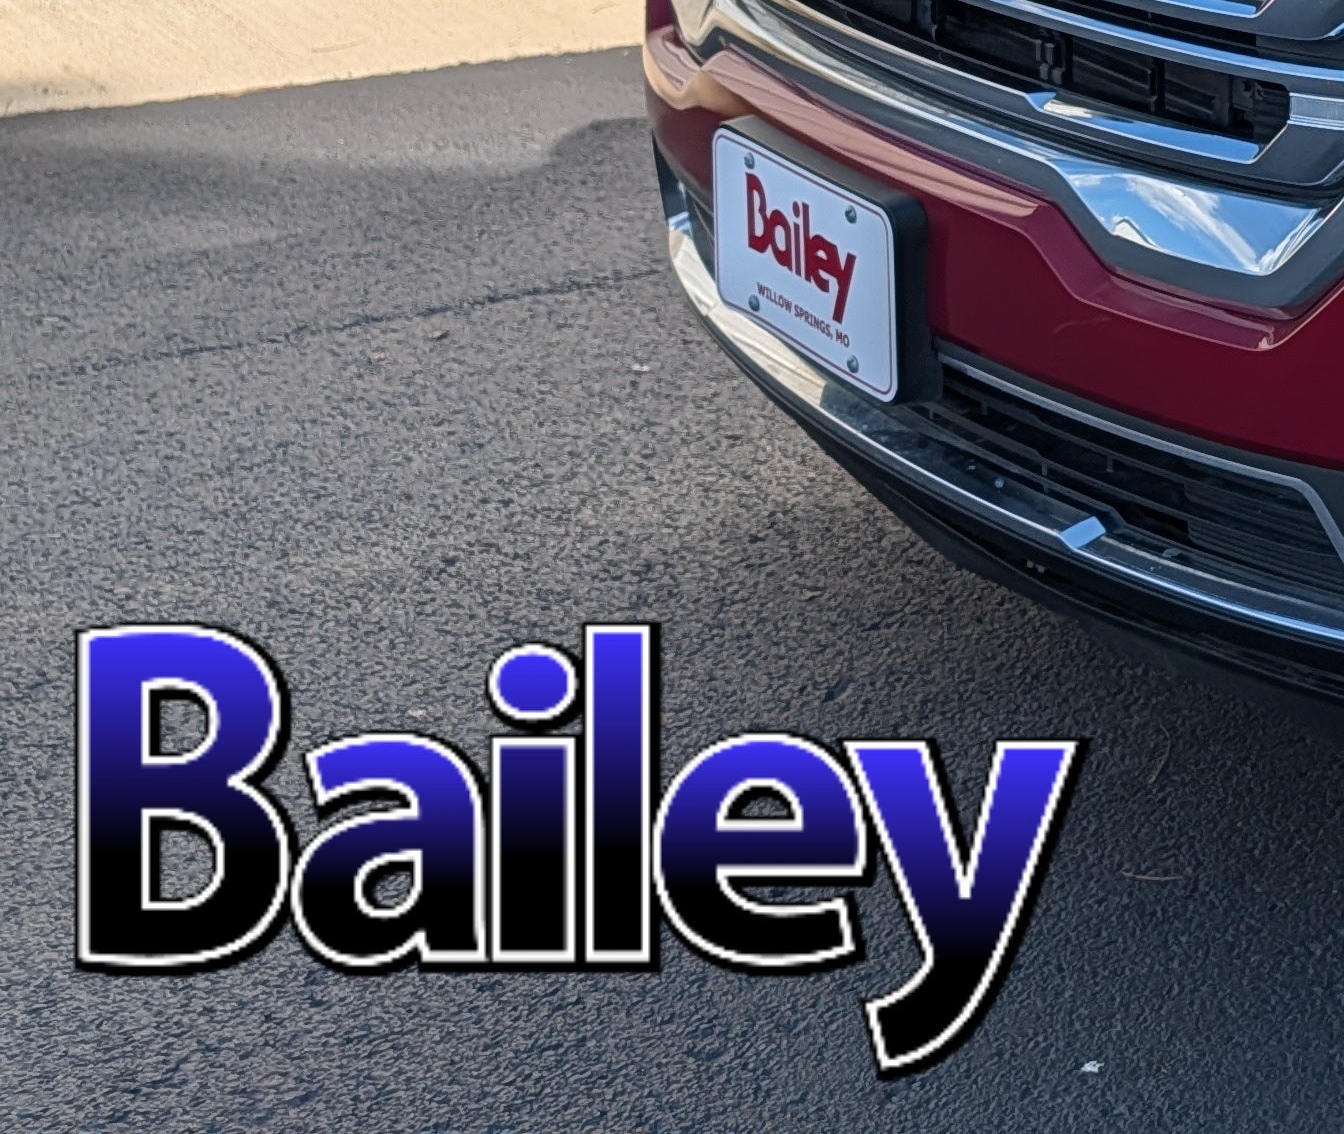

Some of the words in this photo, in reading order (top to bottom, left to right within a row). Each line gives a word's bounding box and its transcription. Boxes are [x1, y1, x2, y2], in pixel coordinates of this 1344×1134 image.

[744, 171, 857, 324] Bailey
[756, 281, 792, 312] WILLOW
[794, 304, 833, 340] SPRINGS,
[835, 330, 850, 348] MO
